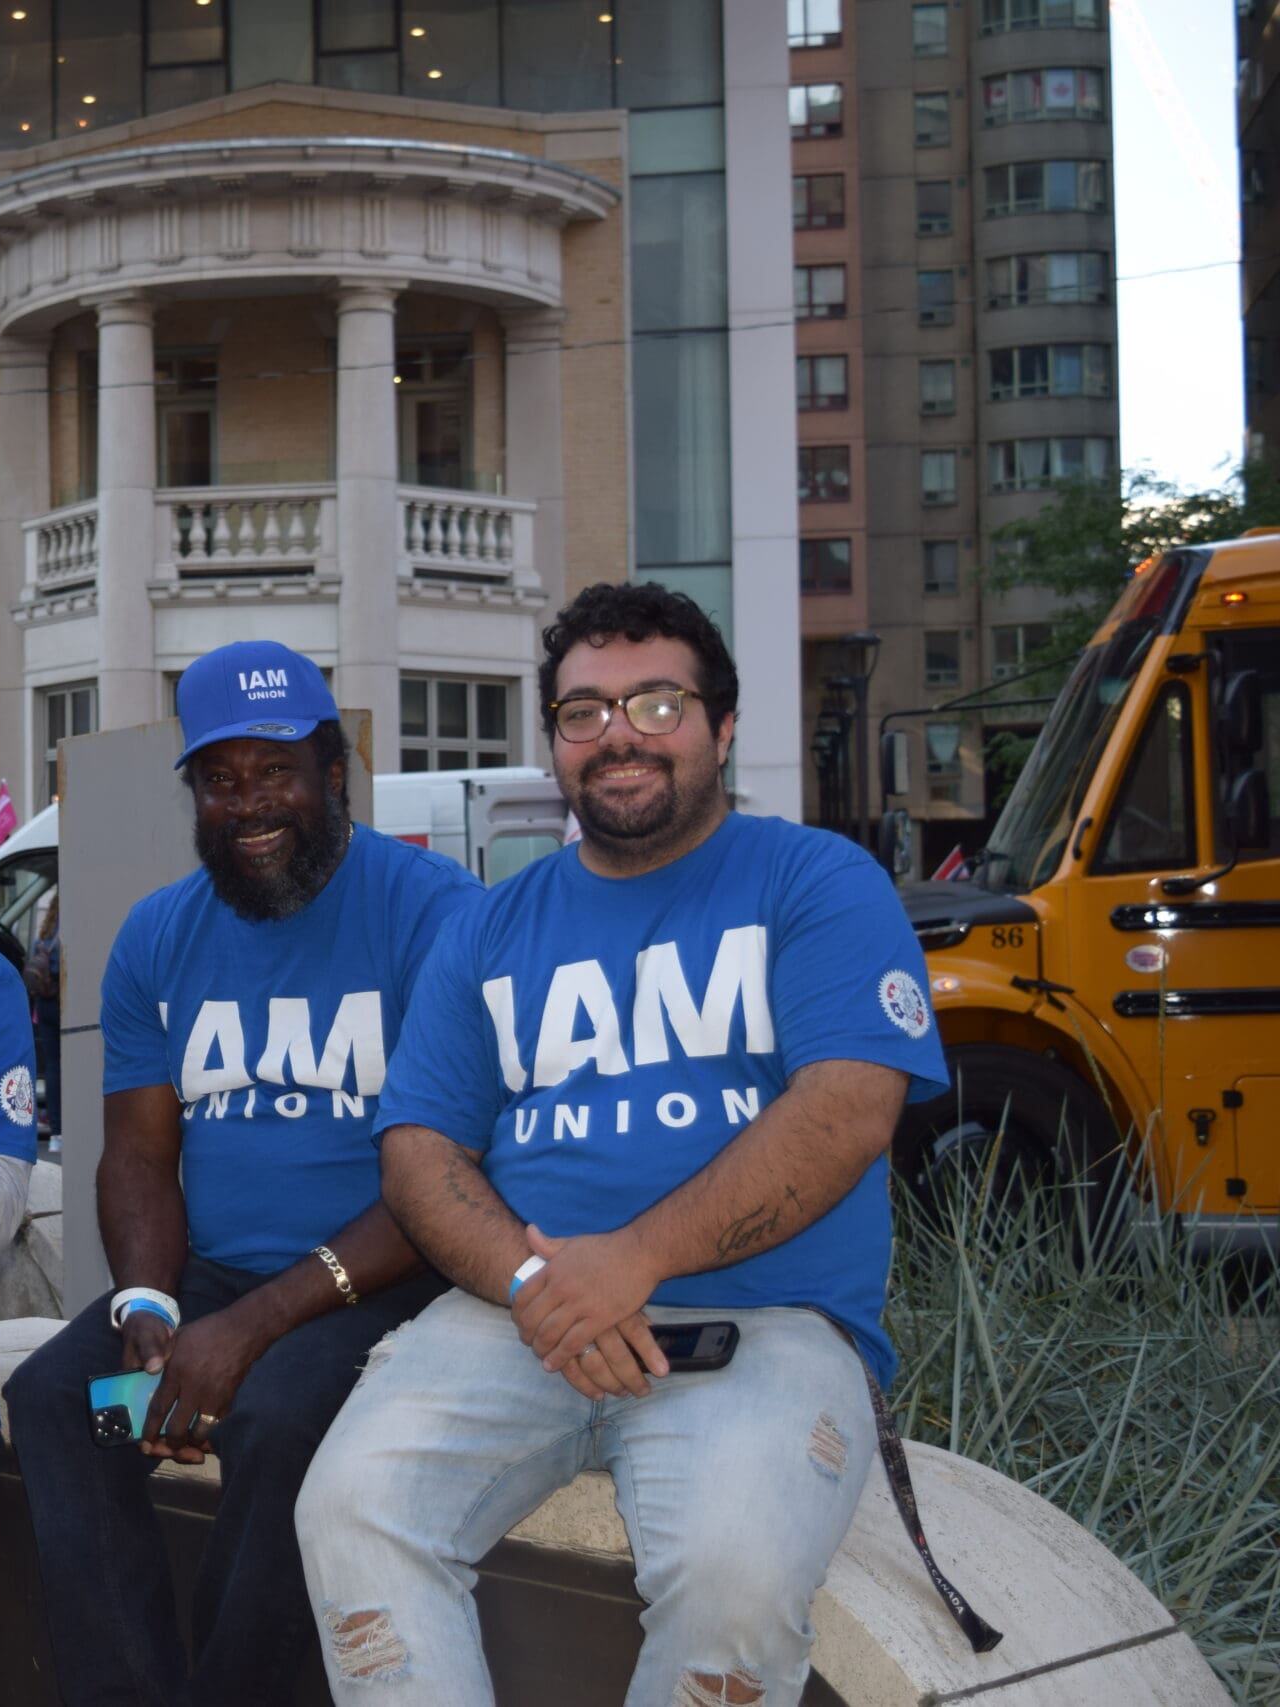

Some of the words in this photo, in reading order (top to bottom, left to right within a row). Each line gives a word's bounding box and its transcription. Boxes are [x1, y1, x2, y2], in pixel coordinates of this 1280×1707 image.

[238, 669, 289, 691] IAM
[247, 689, 287, 701] UNION
[991, 926, 1024, 949] 86
[482, 924, 775, 1094] IAM
[514, 1087, 762, 1144] UNION
[930, 1568, 964, 1615] CANADA
